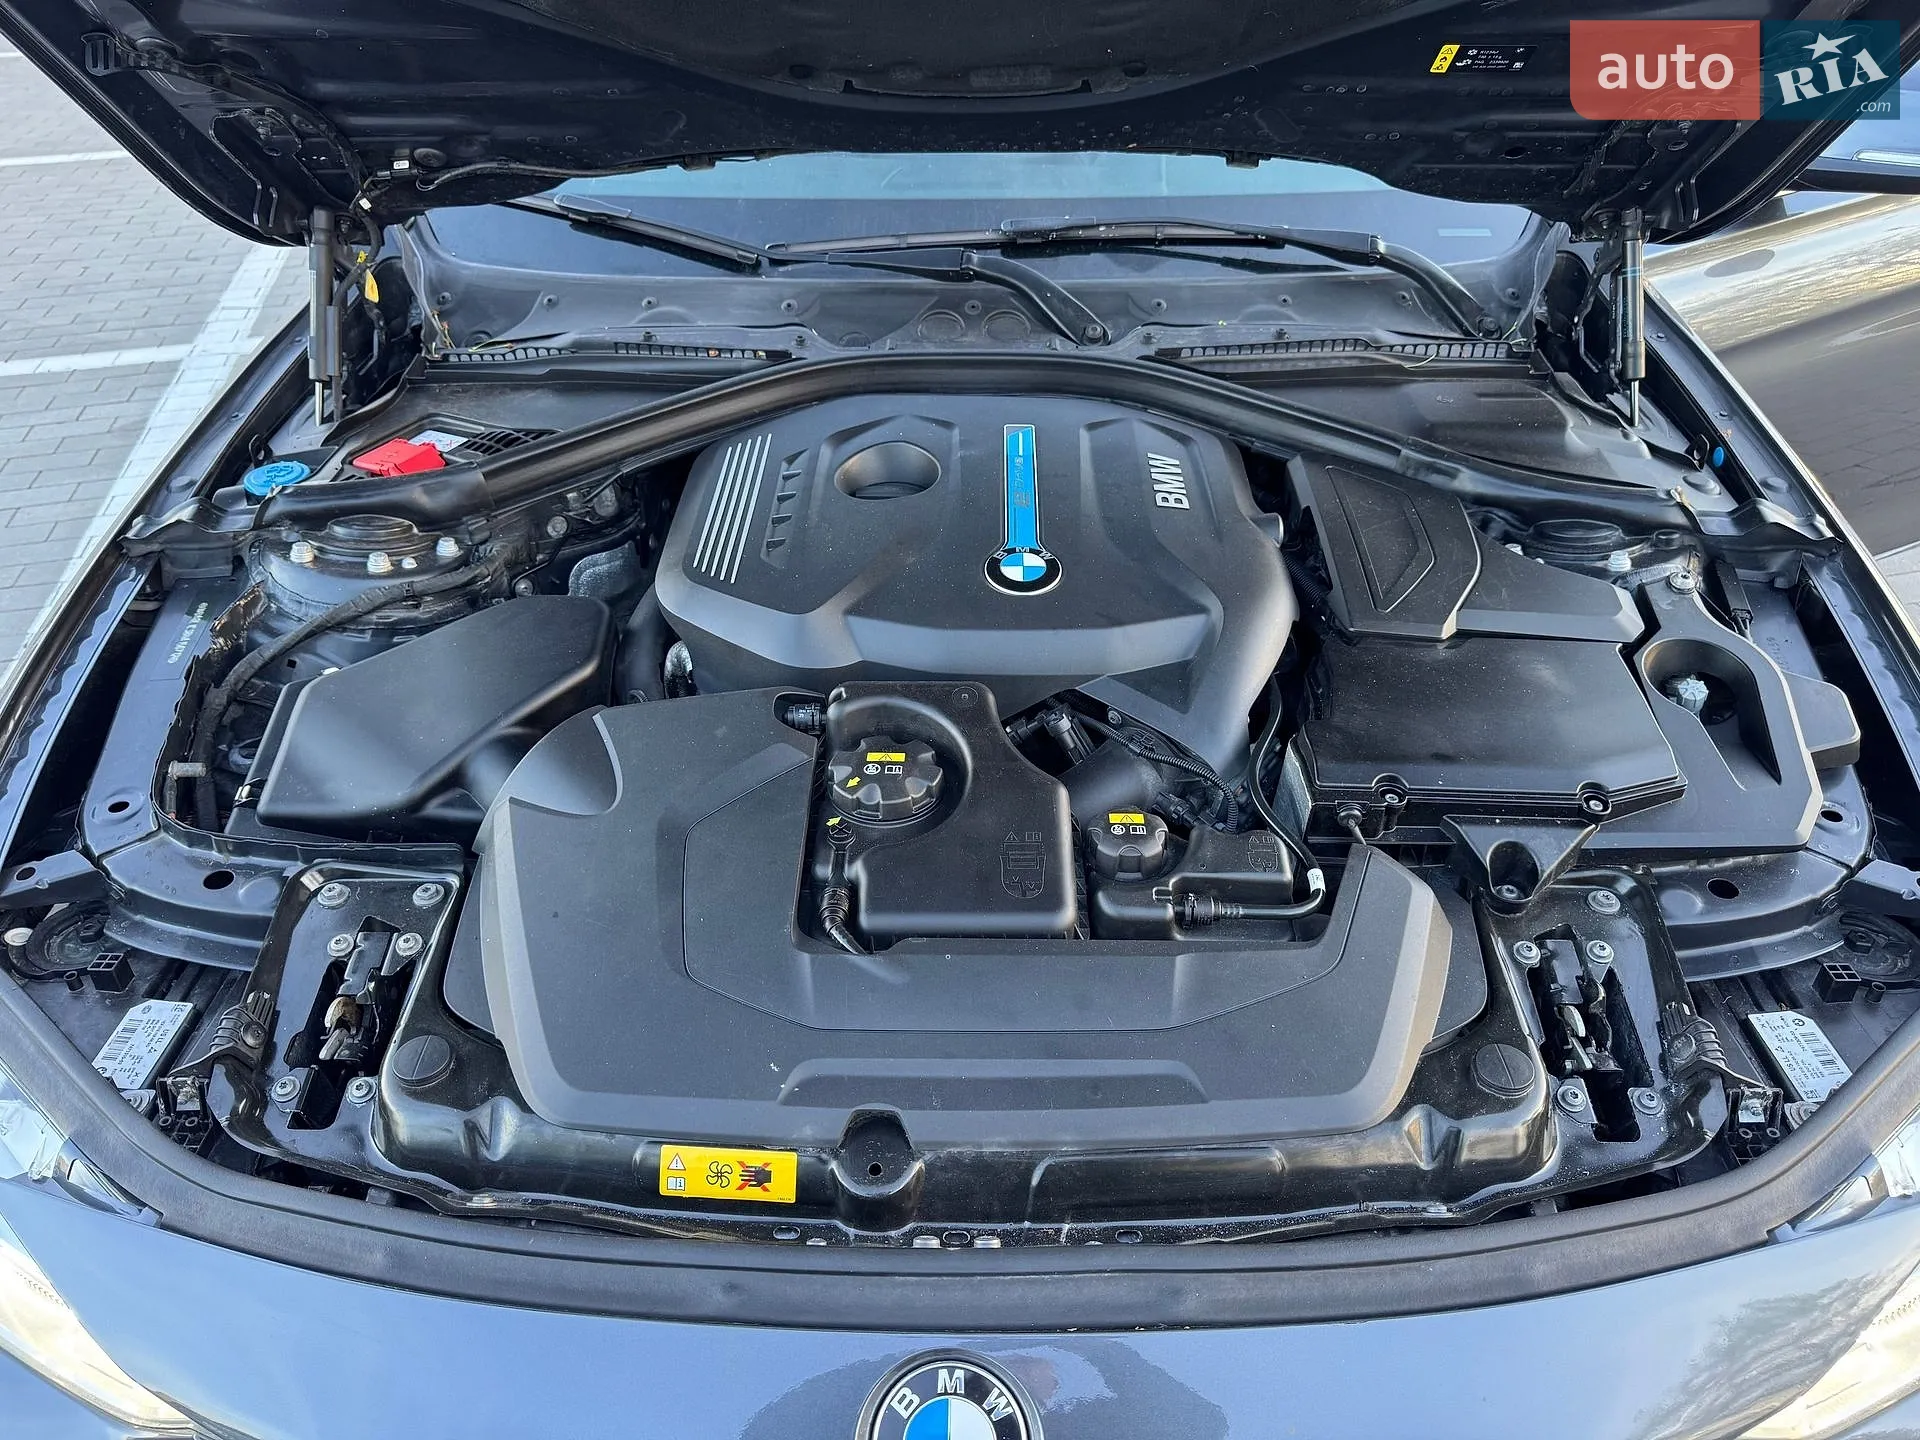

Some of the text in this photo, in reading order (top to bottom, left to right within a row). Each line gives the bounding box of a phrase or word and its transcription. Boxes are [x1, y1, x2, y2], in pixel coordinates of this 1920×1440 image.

[1147, 452, 1190, 510] BMW
[993, 546, 1054, 560] BMW
[889, 1368, 1014, 1422] BMW
